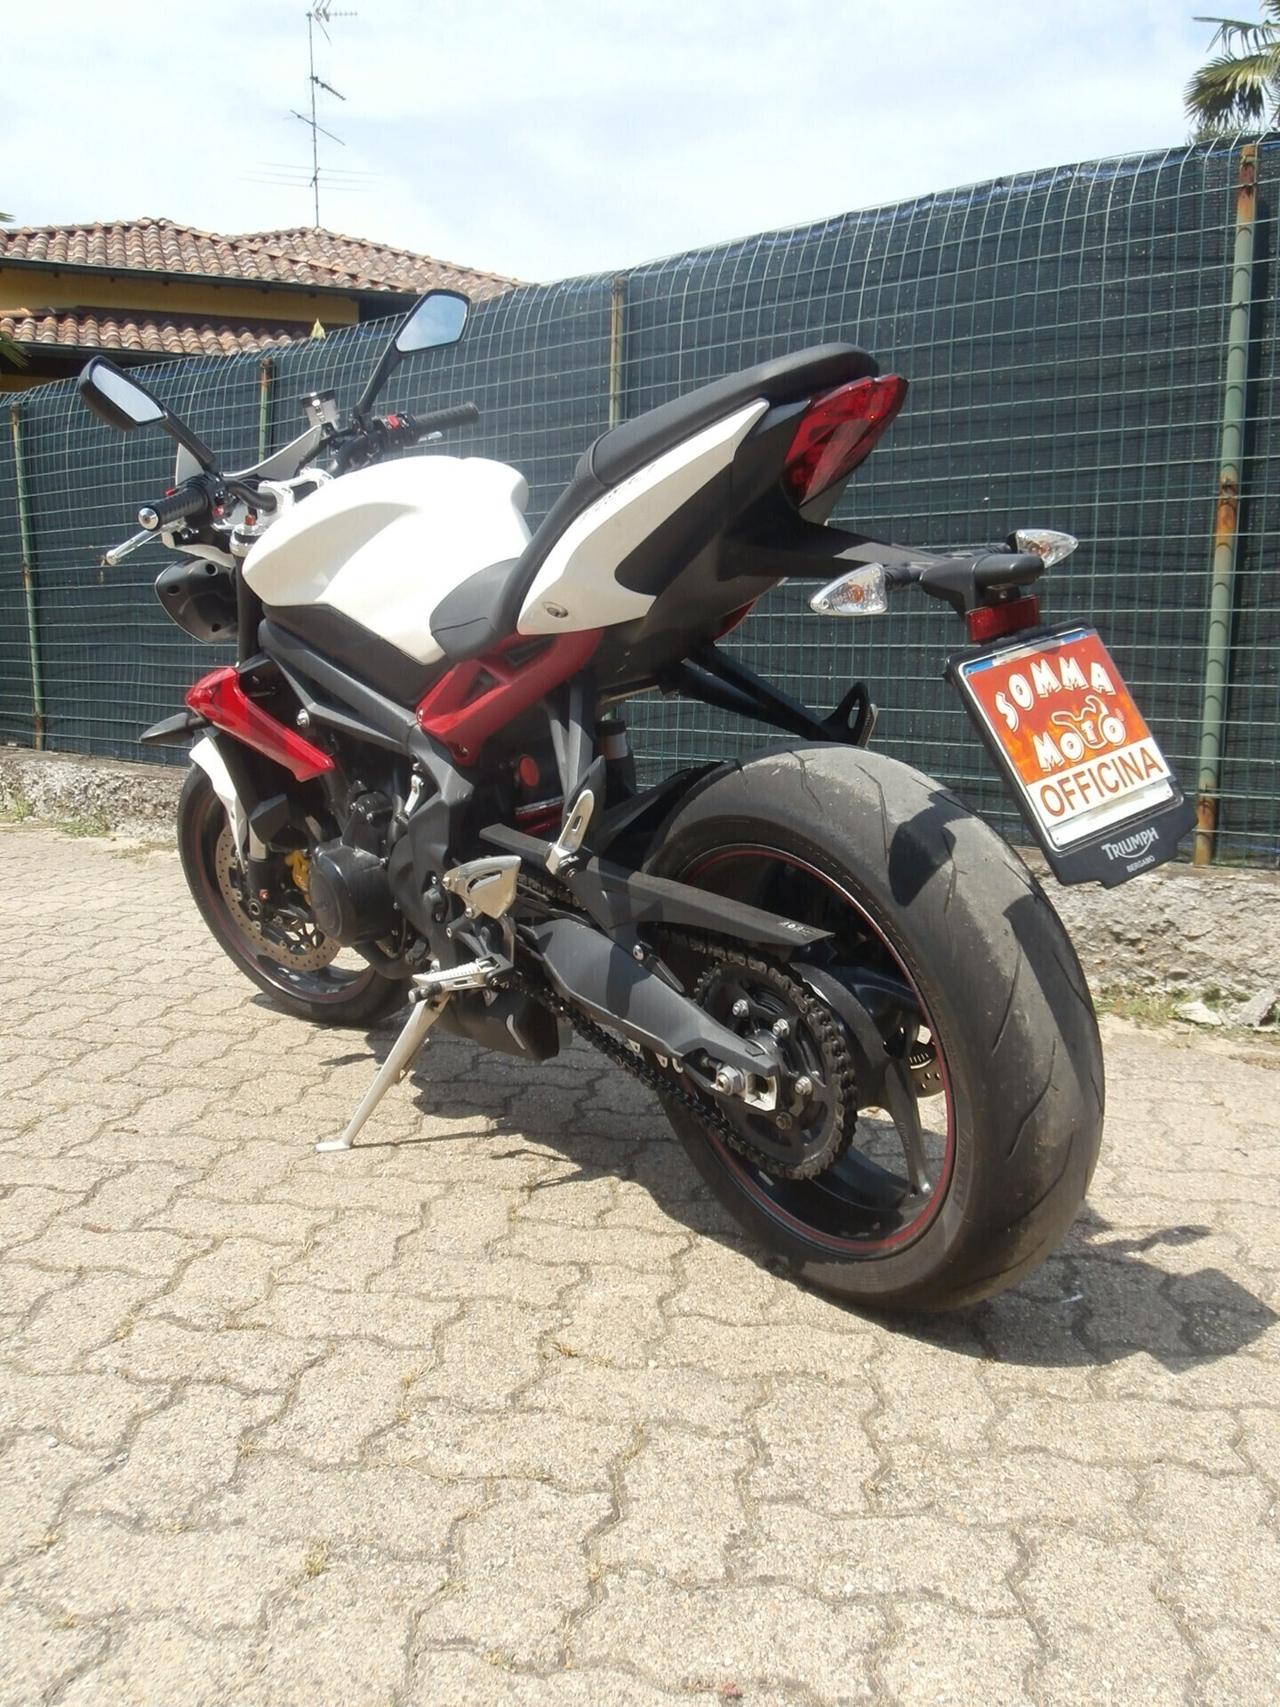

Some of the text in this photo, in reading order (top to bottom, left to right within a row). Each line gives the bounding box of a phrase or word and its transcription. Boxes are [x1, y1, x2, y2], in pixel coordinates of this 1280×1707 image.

[995, 656, 1116, 732] SOMMA
[1032, 715, 1126, 772] MOTO
[1039, 746, 1164, 817] OFFICINA
[1101, 827, 1159, 860] TRIUMPH
